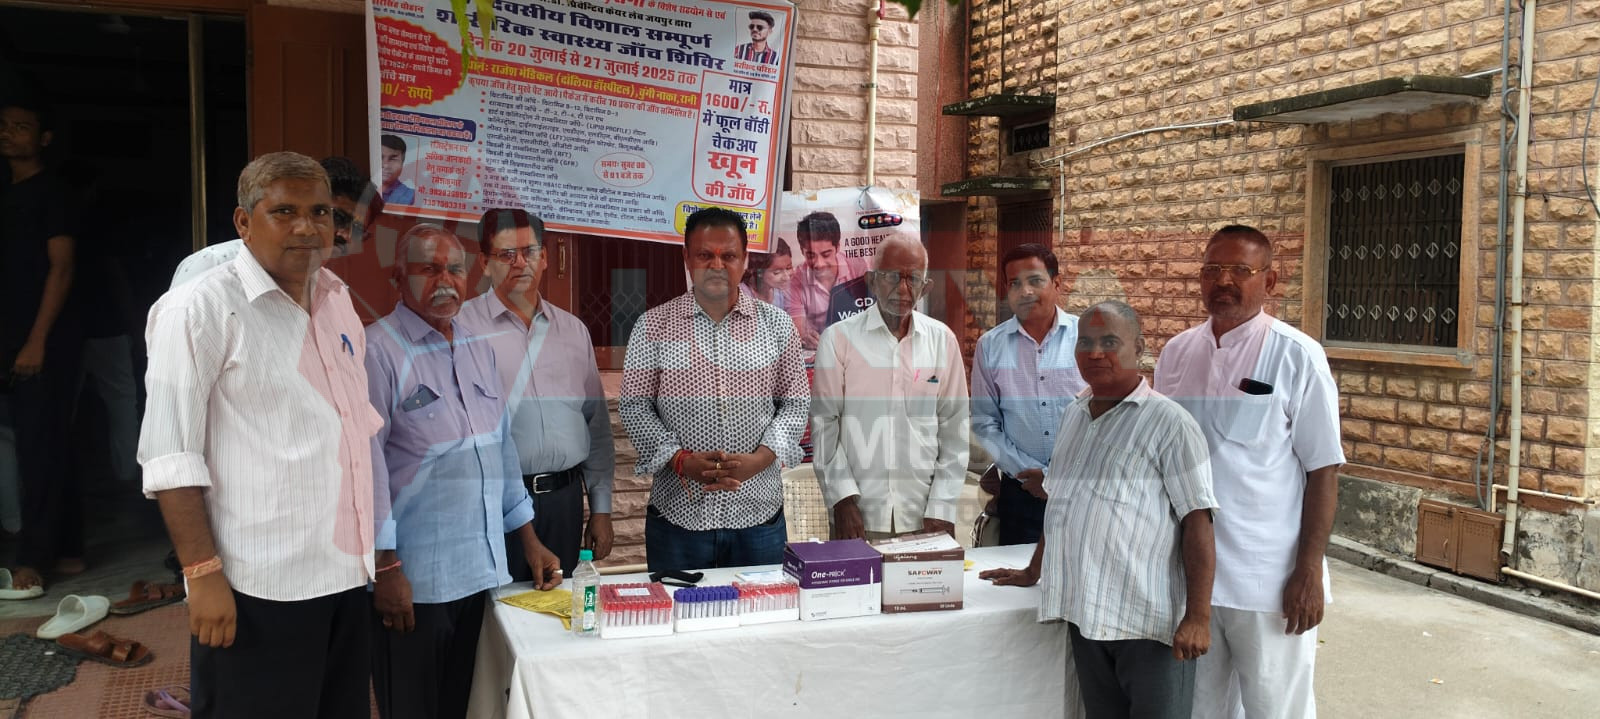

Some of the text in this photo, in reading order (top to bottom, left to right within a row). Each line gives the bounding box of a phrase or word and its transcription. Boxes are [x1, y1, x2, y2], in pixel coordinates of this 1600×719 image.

[645, 14, 674, 27] जयपुर
[570, 12, 642, 37] विशाल
[646, 27, 712, 50] सम्पूर्ण
[539, 28, 613, 52] स्वास्थ्य
[666, 48, 726, 70] शिविर
[508, 42, 526, 56] 20
[529, 46, 568, 66] जुलाई
[570, 50, 581, 66] से
[584, 56, 600, 70] 27
[603, 58, 640, 77] जुलाई
[642, 66, 676, 82] 2025
[678, 73, 698, 86] तक
[728, 78, 752, 96] मात्र
[705, 92, 754, 112] 1600/-
[702, 110, 770, 134] में फूल बॉडी
[712, 132, 758, 154] चेकअप
[708, 151, 759, 180] खून
[705, 181, 726, 198] की
[845, 238, 849, 247] A
[850, 236, 870, 247] GOOD
[845, 247, 876, 258] THE BEST
[855, 298, 874, 307] GD
